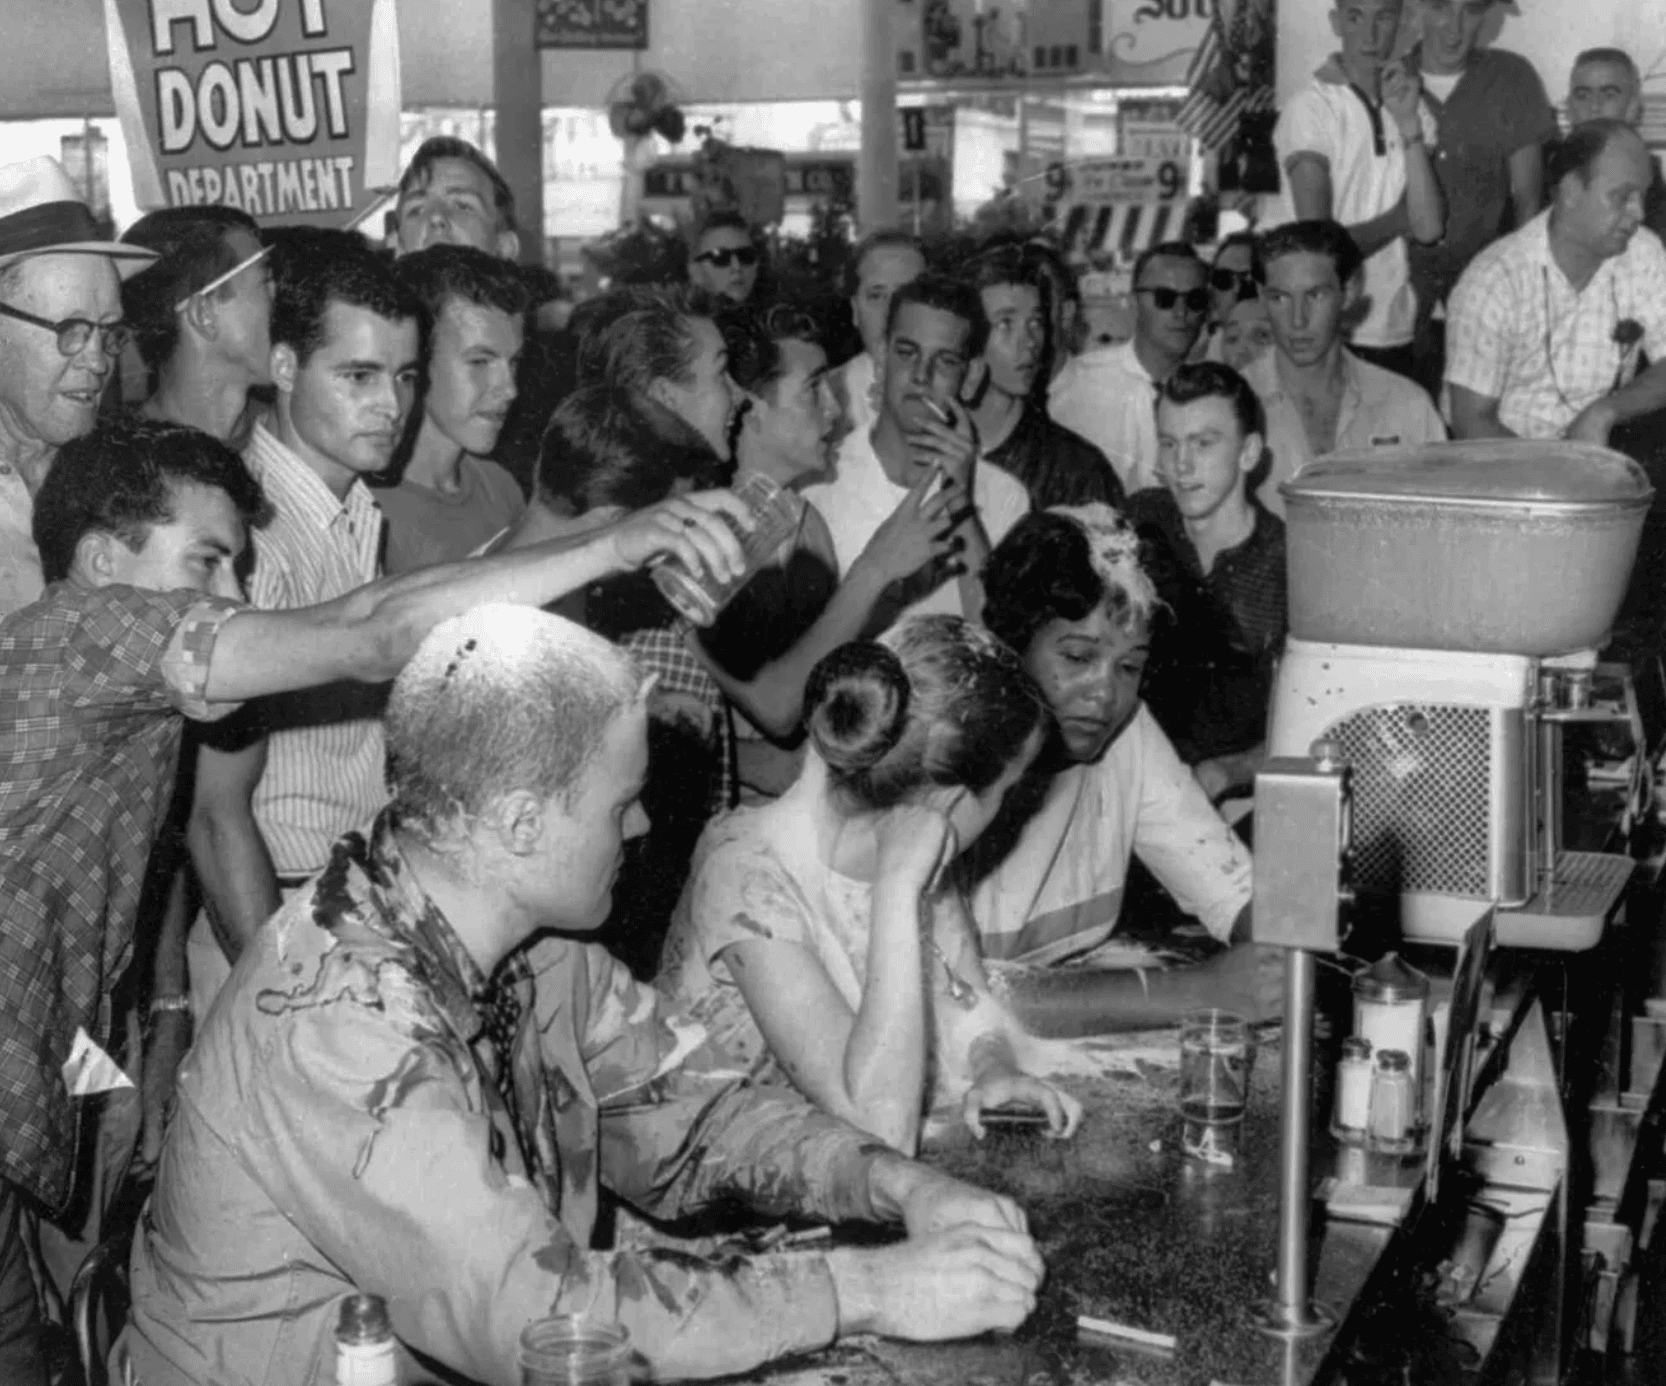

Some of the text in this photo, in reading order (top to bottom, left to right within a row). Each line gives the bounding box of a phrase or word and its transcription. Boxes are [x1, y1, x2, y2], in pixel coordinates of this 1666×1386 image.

[155, 46, 354, 155] DONUT
[168, 156, 354, 215] DEPARTMENT
[1158, 160, 1182, 201] 9
